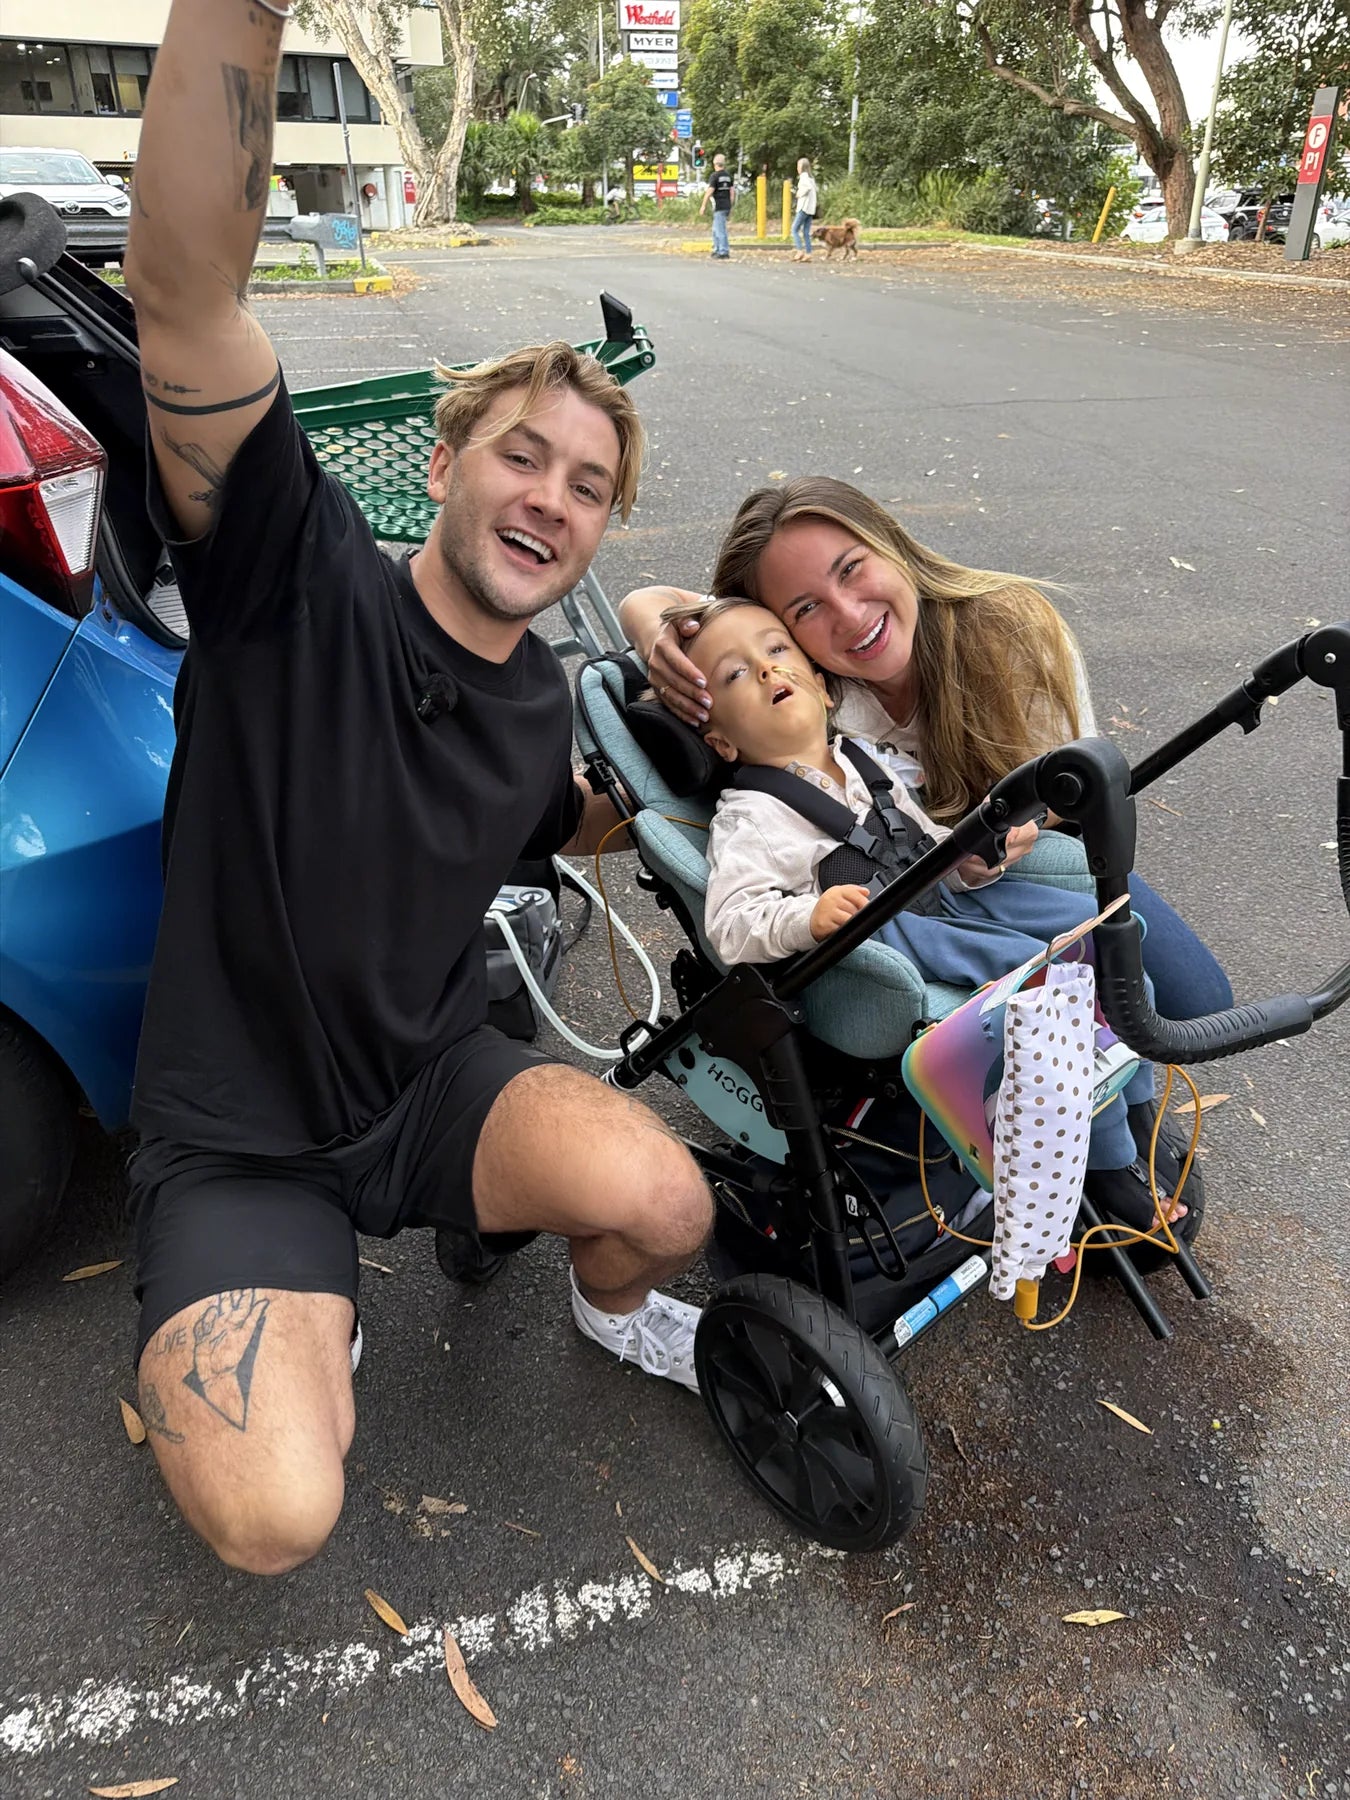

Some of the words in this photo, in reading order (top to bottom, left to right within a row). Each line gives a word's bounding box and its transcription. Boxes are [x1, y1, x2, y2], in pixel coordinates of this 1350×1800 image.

[625, 5, 676, 25] Westfield
[634, 37, 674, 46] MYER
[1313, 127, 1322, 145] F
[1304, 151, 1320, 170] P1
